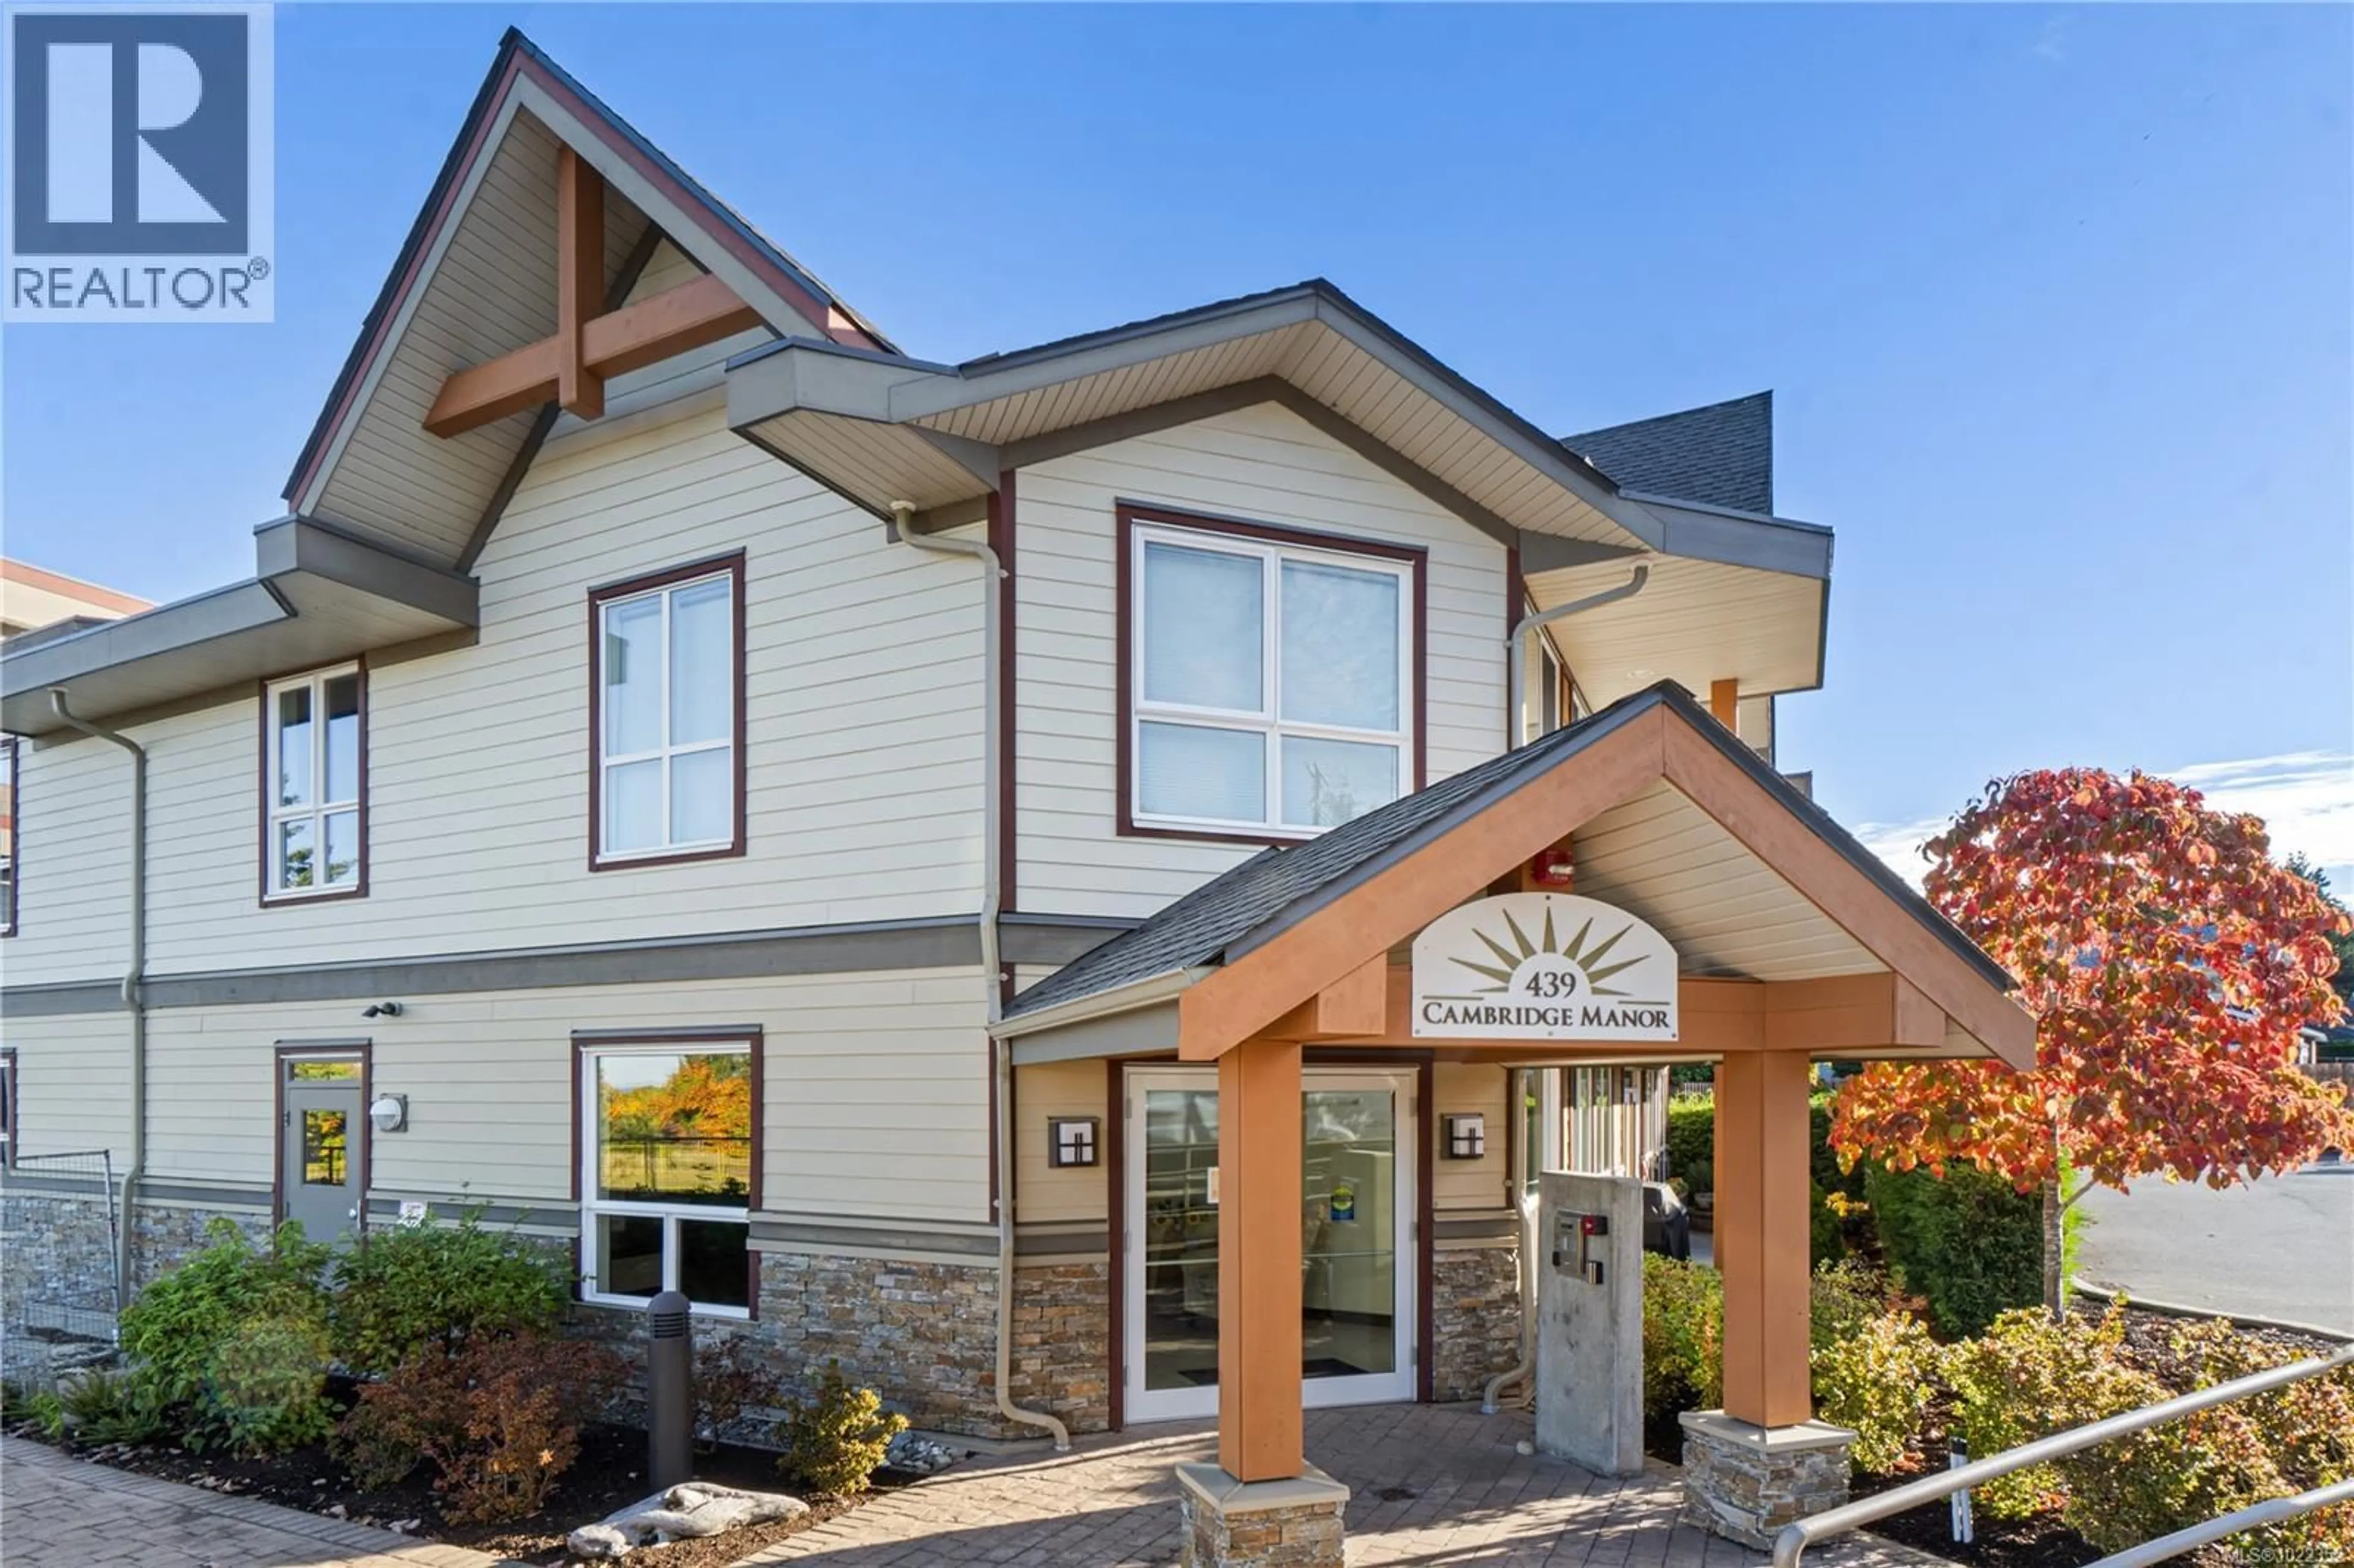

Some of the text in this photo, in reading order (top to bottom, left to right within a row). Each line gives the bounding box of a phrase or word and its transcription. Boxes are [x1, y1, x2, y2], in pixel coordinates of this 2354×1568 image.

[1525, 971, 1577, 999] 439
[1422, 1002, 1670, 1029] CAMBRIDGE MANOR
